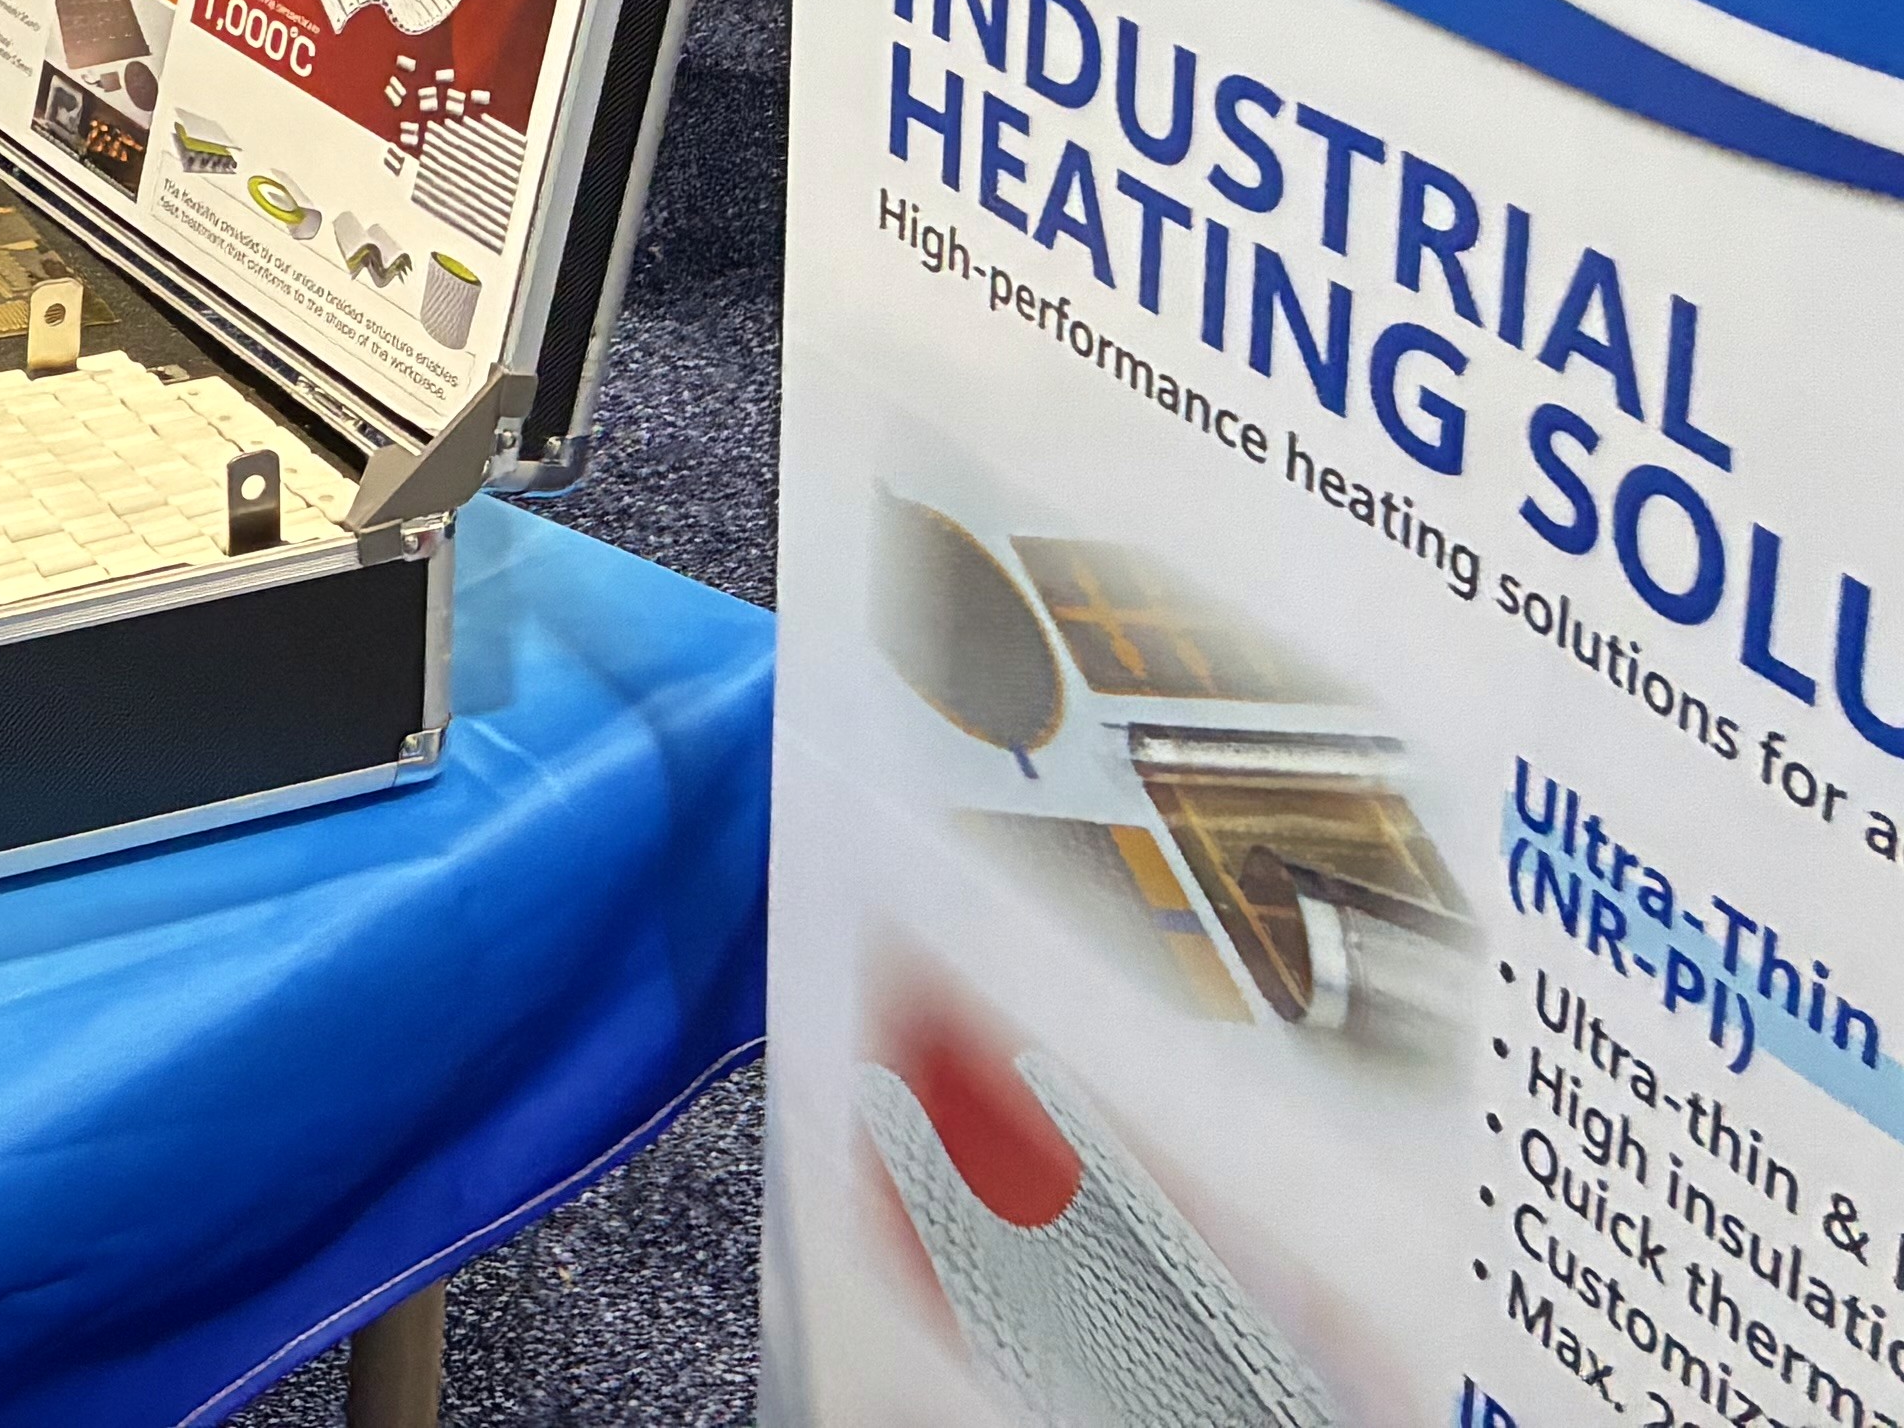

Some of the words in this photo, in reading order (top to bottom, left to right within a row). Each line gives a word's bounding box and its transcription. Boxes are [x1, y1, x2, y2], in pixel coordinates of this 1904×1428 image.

[888, 41, 1470, 478] HEATING
[877, 187, 1270, 465] High-performance
[1287, 430, 1481, 602] heating
[1496, 569, 1739, 761] solutions
[1758, 730, 1848, 824] for
[1506, 837, 1758, 1075] (NR-PI)
[1512, 755, 1882, 1070] Ultra-Thin
[1518, 1127, 1665, 1284] Quick
[1526, 1046, 1649, 1187] High
[1535, 970, 1798, 1216] Ultra-thin
[1821, 1191, 1870, 1265] &
[1508, 1270, 1624, 1413] Max.
